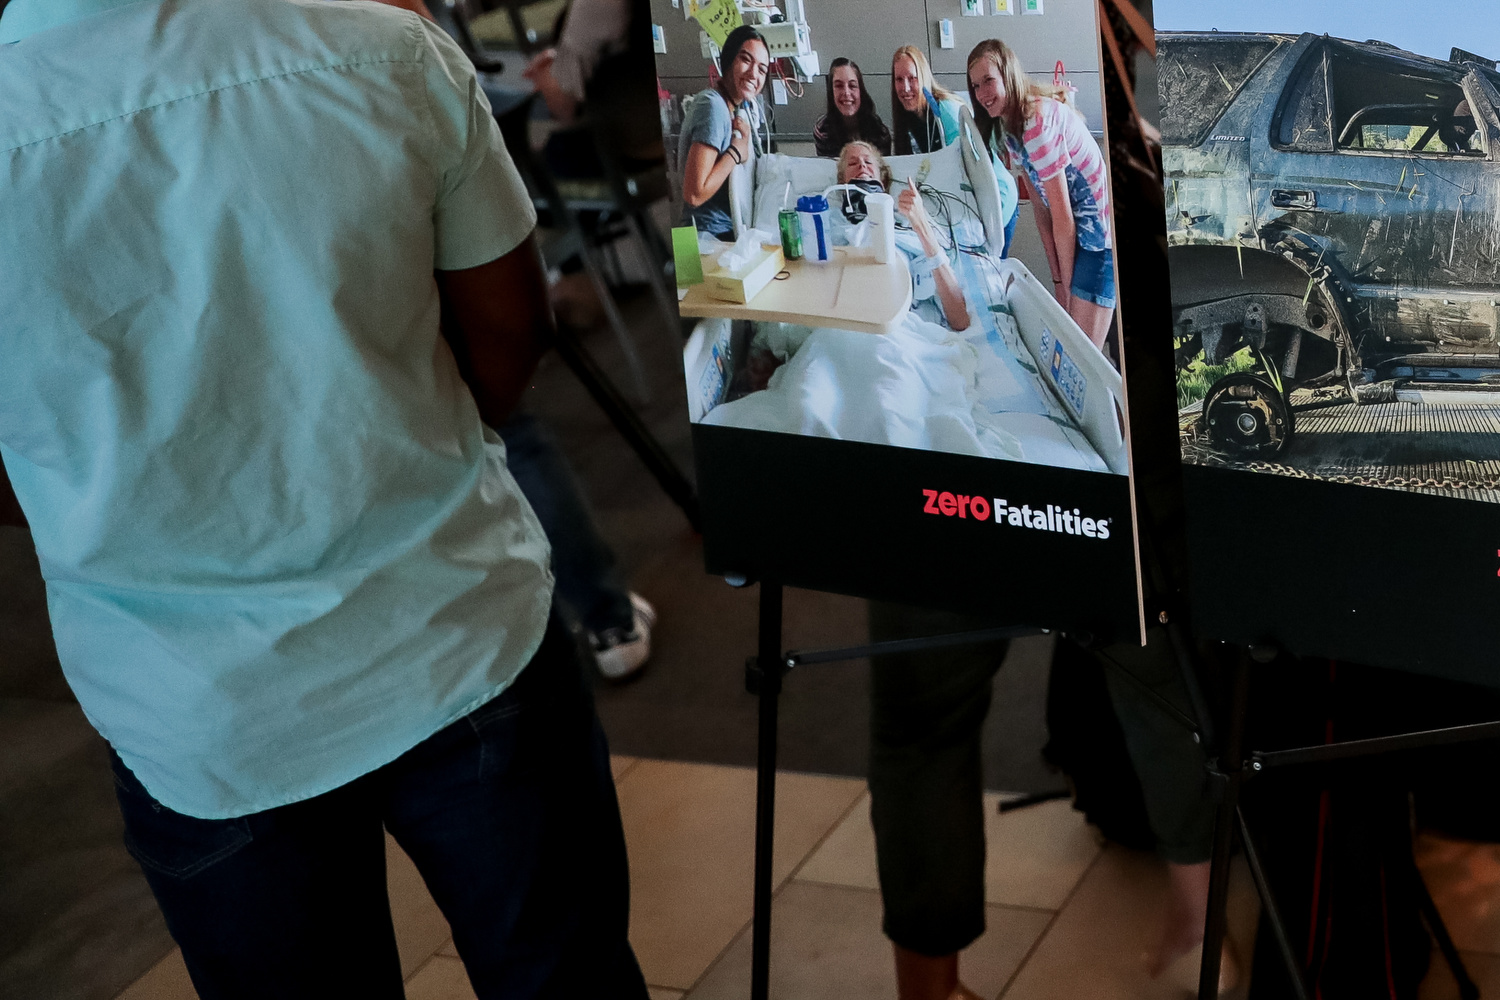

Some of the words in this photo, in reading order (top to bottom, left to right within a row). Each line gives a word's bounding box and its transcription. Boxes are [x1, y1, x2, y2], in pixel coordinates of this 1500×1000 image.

[1210, 134, 1246, 142] LIMITED
[922, 488, 991, 522] zero
[993, 497, 1111, 540] Fatalities
